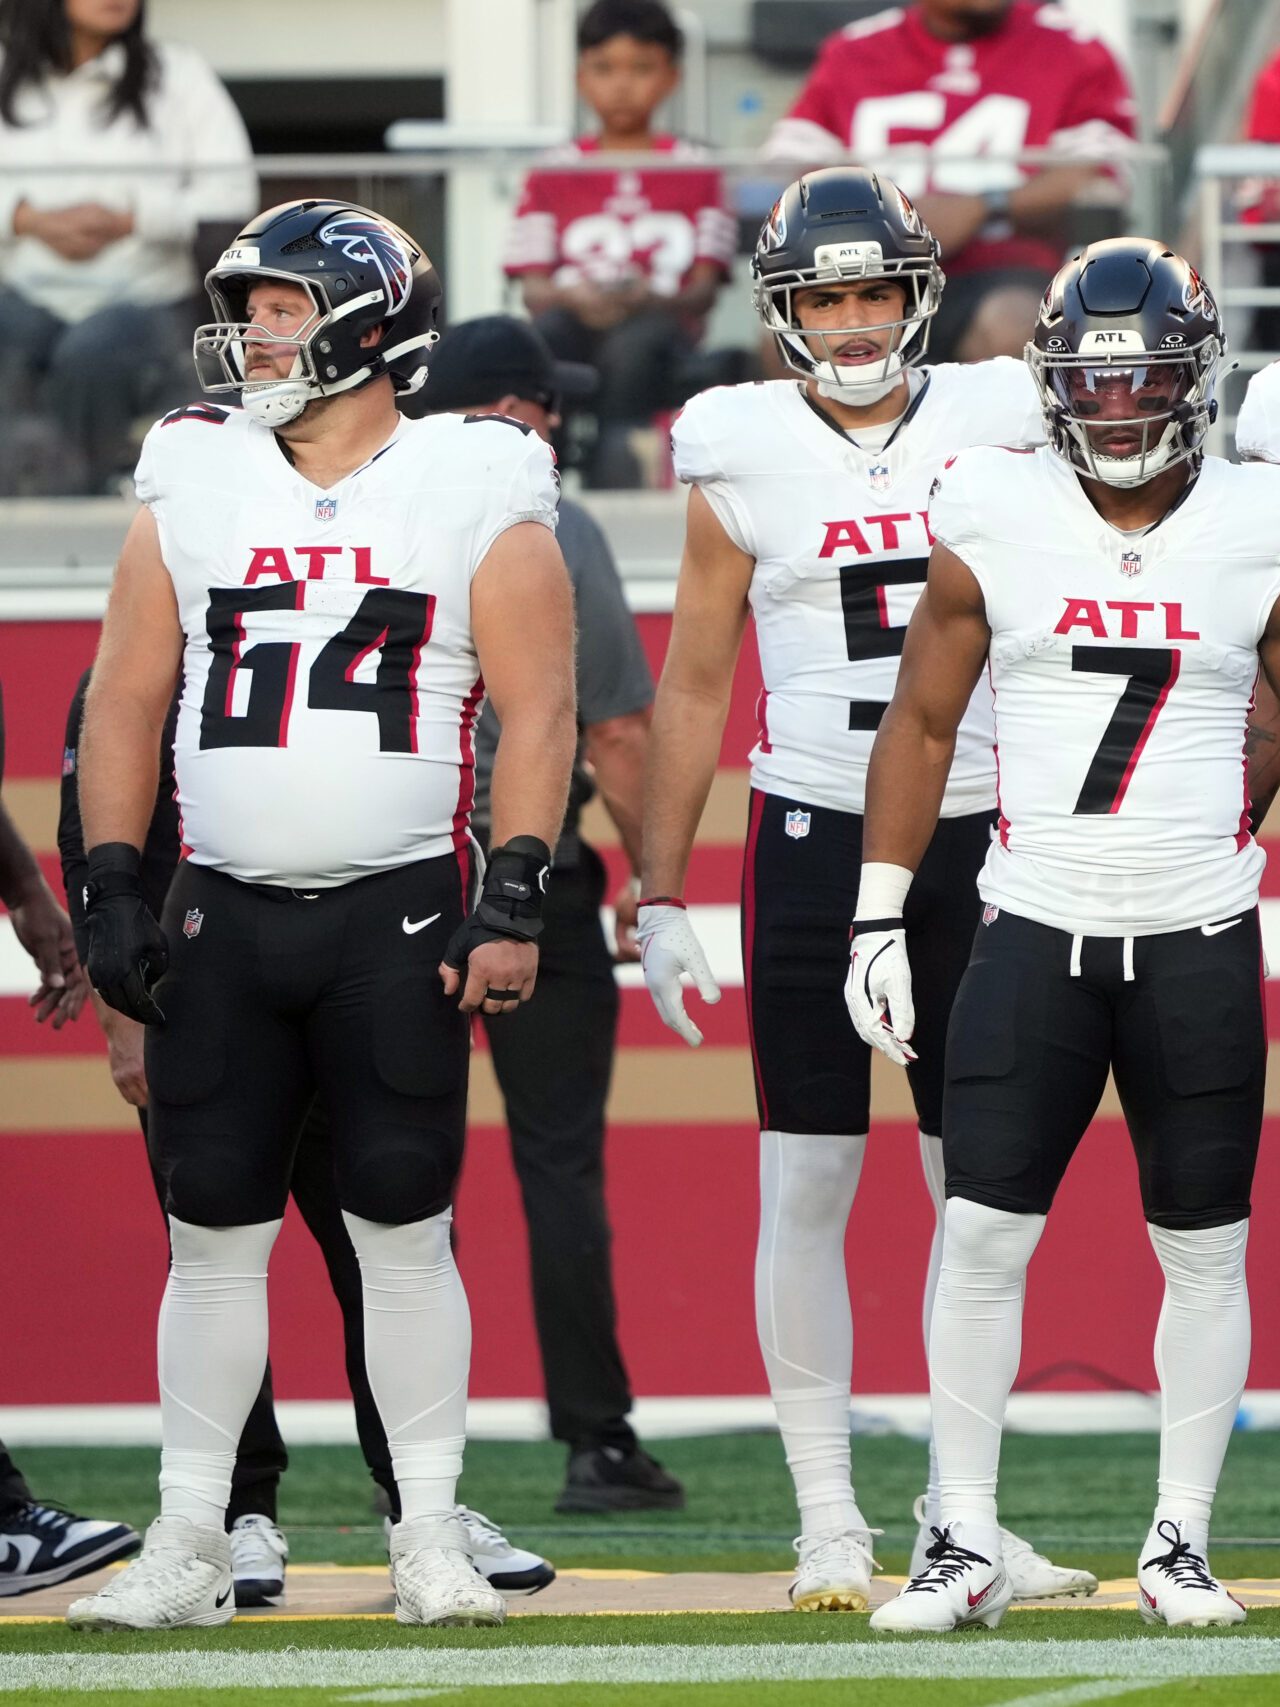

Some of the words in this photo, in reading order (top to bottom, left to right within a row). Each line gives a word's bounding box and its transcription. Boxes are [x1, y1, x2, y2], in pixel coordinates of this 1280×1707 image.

[853, 91, 1032, 197] 54
[223, 250, 242, 260] ATL
[840, 248, 861, 257] ATL
[1094, 332, 1127, 343] ATL
[243, 547, 390, 585] ATL
[1053, 597, 1200, 640] ATL
[199, 579, 437, 754] 64
[1071, 645, 1182, 815] 7
